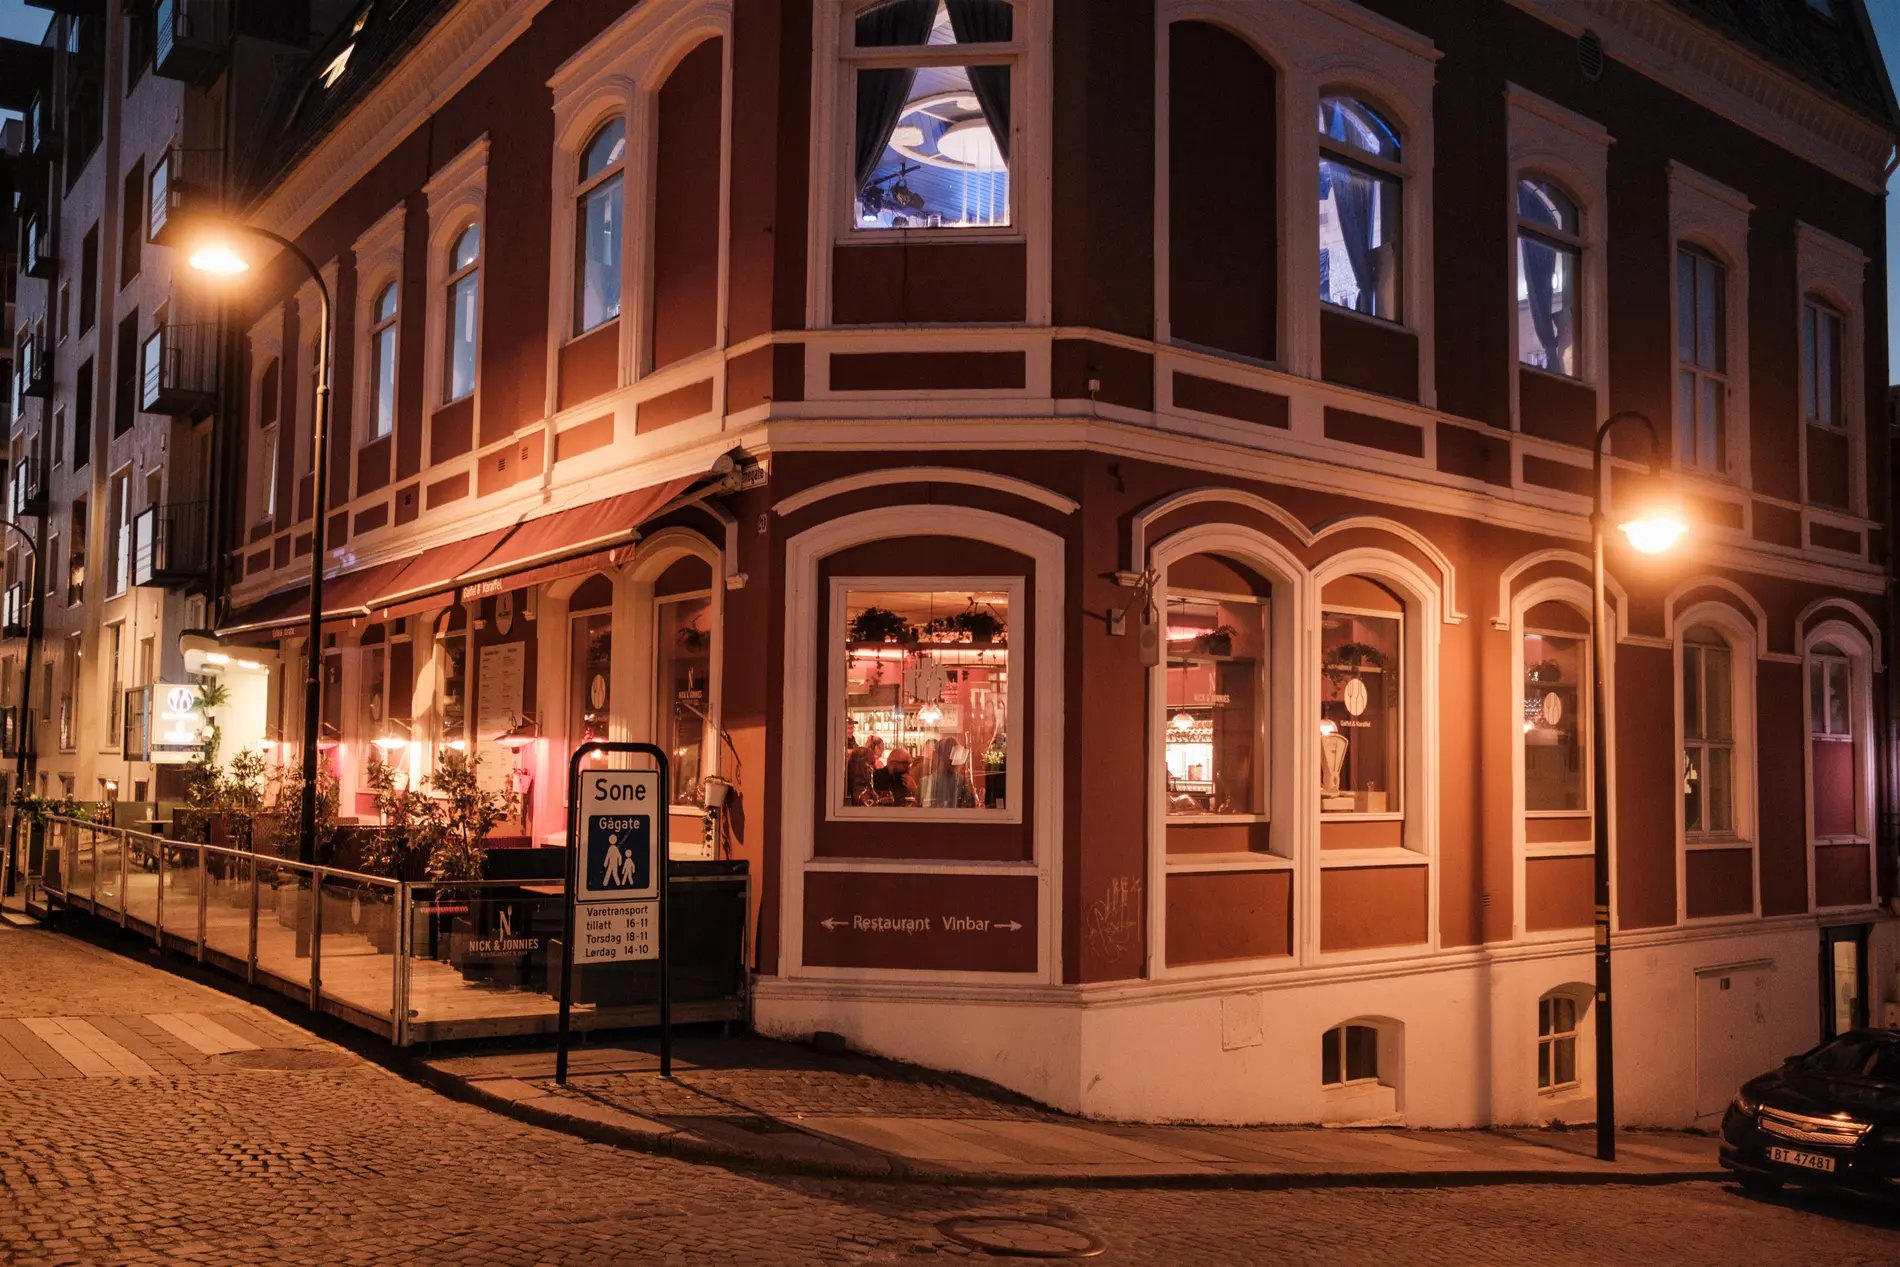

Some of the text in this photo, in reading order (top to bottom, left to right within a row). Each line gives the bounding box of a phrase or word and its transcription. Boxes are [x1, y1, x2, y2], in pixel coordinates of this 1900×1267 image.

[594, 778, 646, 801] Sone
[599, 817, 641, 833] Gågate
[587, 905, 648, 918] Varetransport
[586, 918, 648, 930] tillatt 16-11
[853, 915, 990, 932] Restaurant Vinbar
[469, 938, 539, 952] NICK & JONNIES
[586, 931, 648, 945] Torsdag 18-11
[585, 944, 649, 958] Lørdag 14-10
[1774, 1148, 1831, 1170] BT 47481
